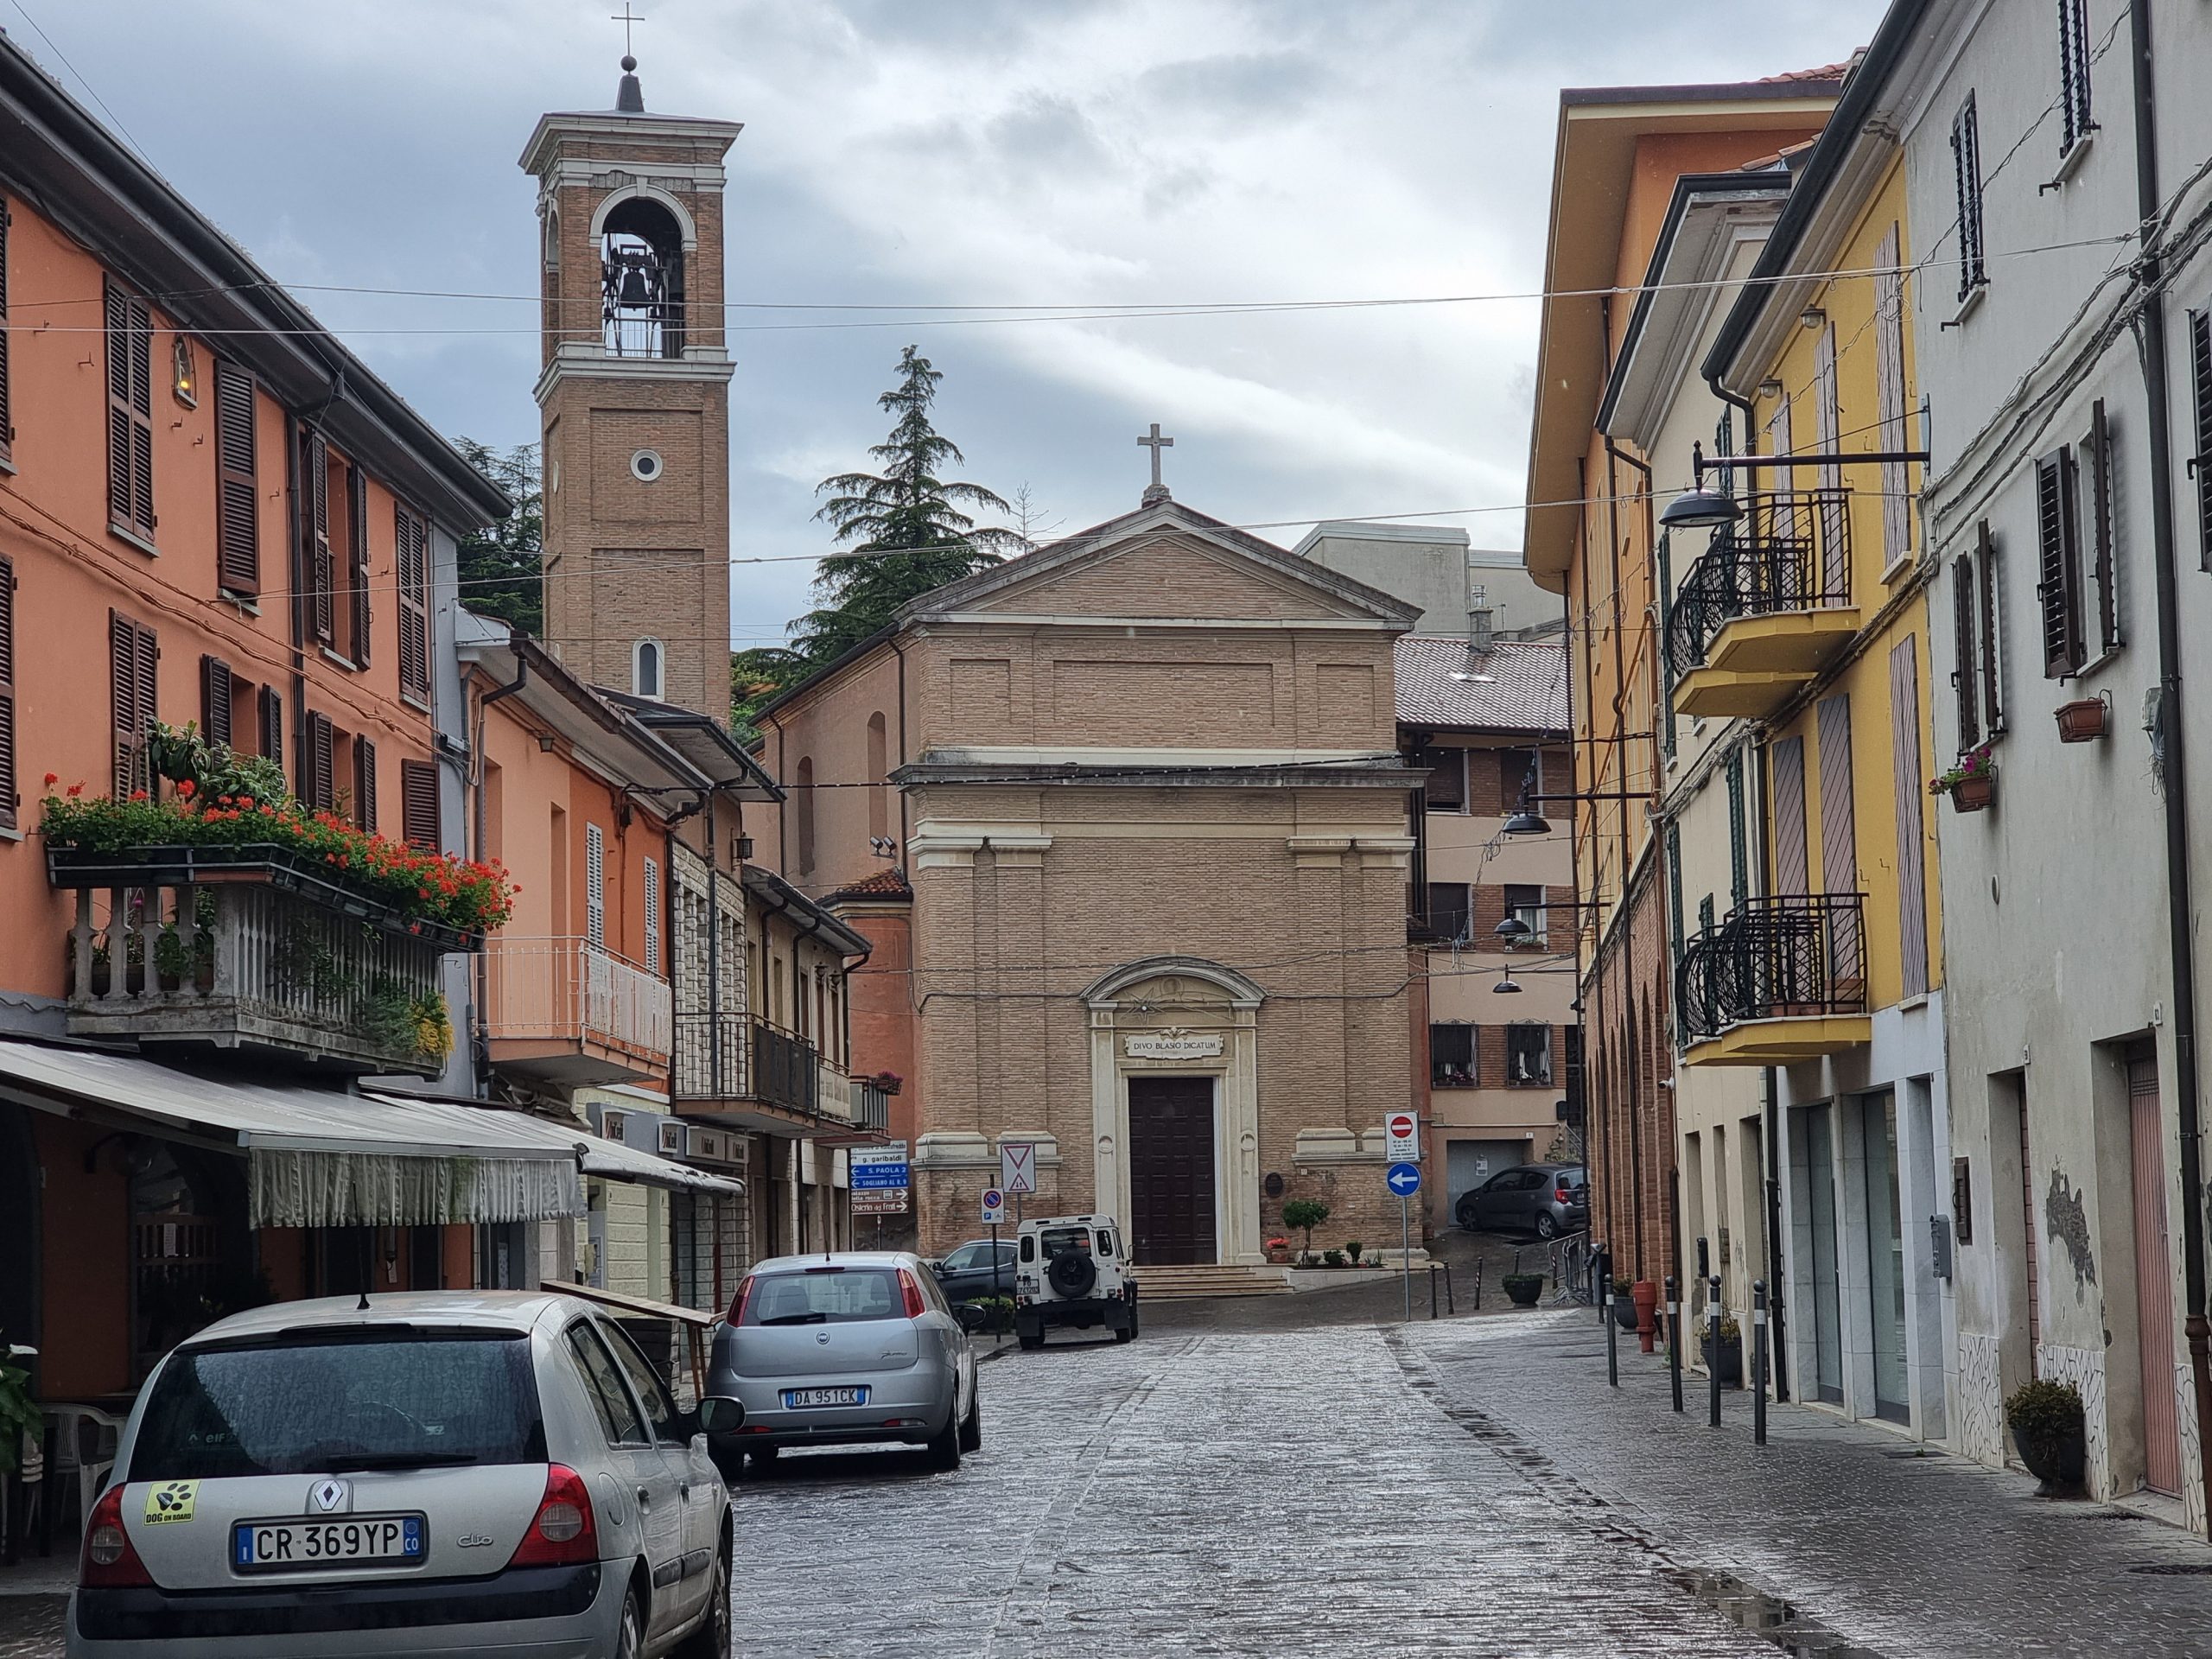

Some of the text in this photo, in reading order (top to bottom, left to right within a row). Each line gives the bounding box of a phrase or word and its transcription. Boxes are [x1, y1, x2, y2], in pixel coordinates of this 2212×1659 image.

[871, 1154, 902, 1163] garibaldi
[795, 1391, 811, 1405] DA
[815, 1389, 856, 1404] 951CK
[146, 1512, 163, 1523] DOG
[257, 1529, 293, 1560] CR
[304, 1523, 399, 1557] 369YP
[404, 1537, 419, 1552] CO
